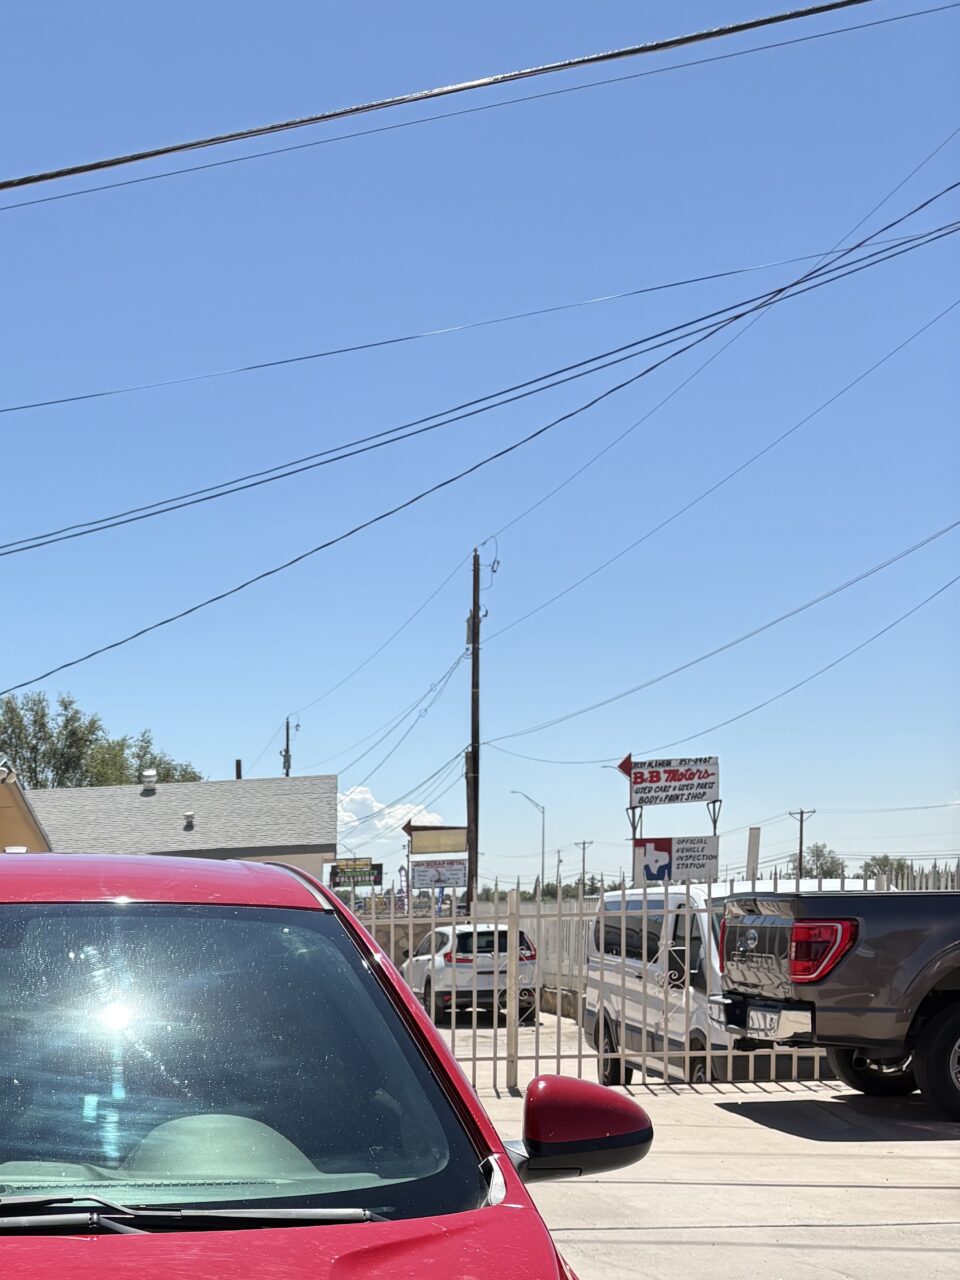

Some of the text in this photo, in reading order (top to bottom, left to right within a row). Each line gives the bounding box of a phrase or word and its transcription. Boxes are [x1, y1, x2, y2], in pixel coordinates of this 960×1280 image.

[663, 768, 715, 782] Motors
[634, 786, 652, 794] USED
[653, 784, 671, 793] CARS
[678, 783, 694, 791] USED
[695, 782, 715, 790] PARTS
[638, 795, 659, 805] BODY
[664, 793, 686, 803] PAINT
[685, 791, 707, 801] SHOP
